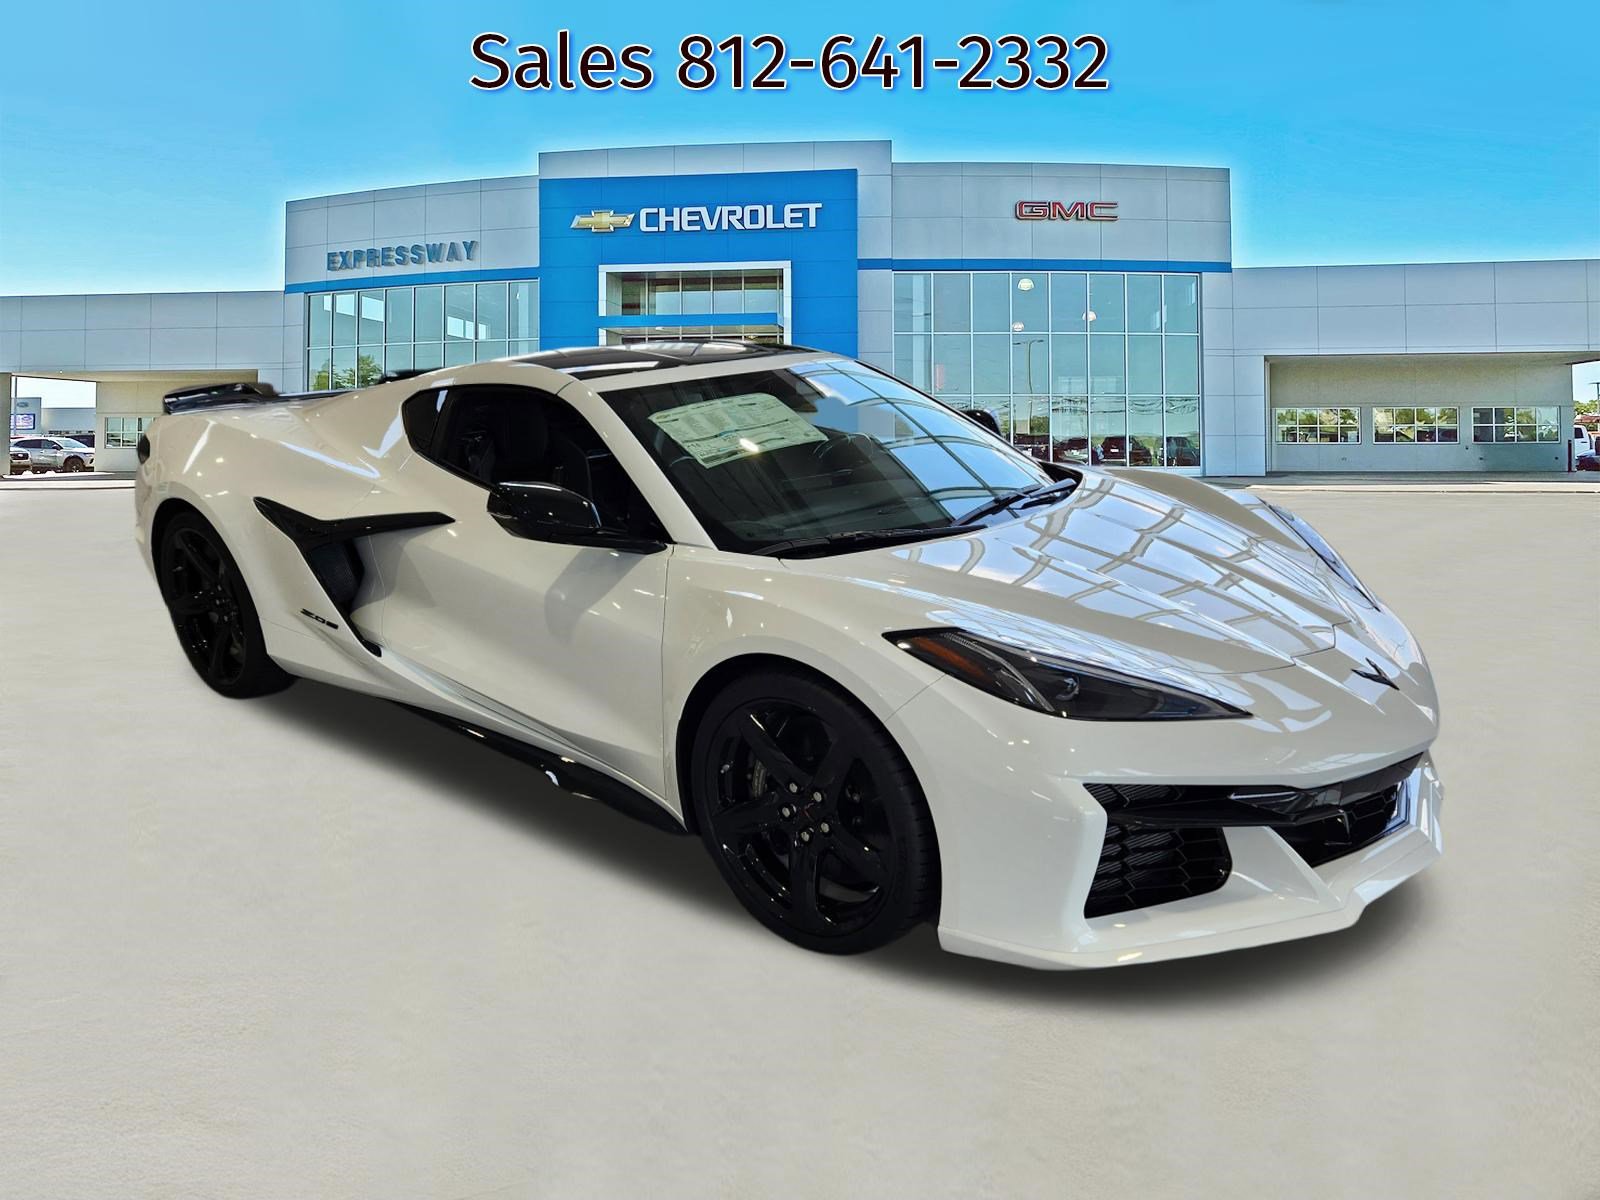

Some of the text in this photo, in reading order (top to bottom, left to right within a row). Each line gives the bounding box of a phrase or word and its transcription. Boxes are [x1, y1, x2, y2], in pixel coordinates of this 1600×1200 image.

[638, 203, 823, 232] CHEVROLET
[1015, 200, 1119, 220] GMC
[326, 240, 479, 272] EXPRESSWAY
